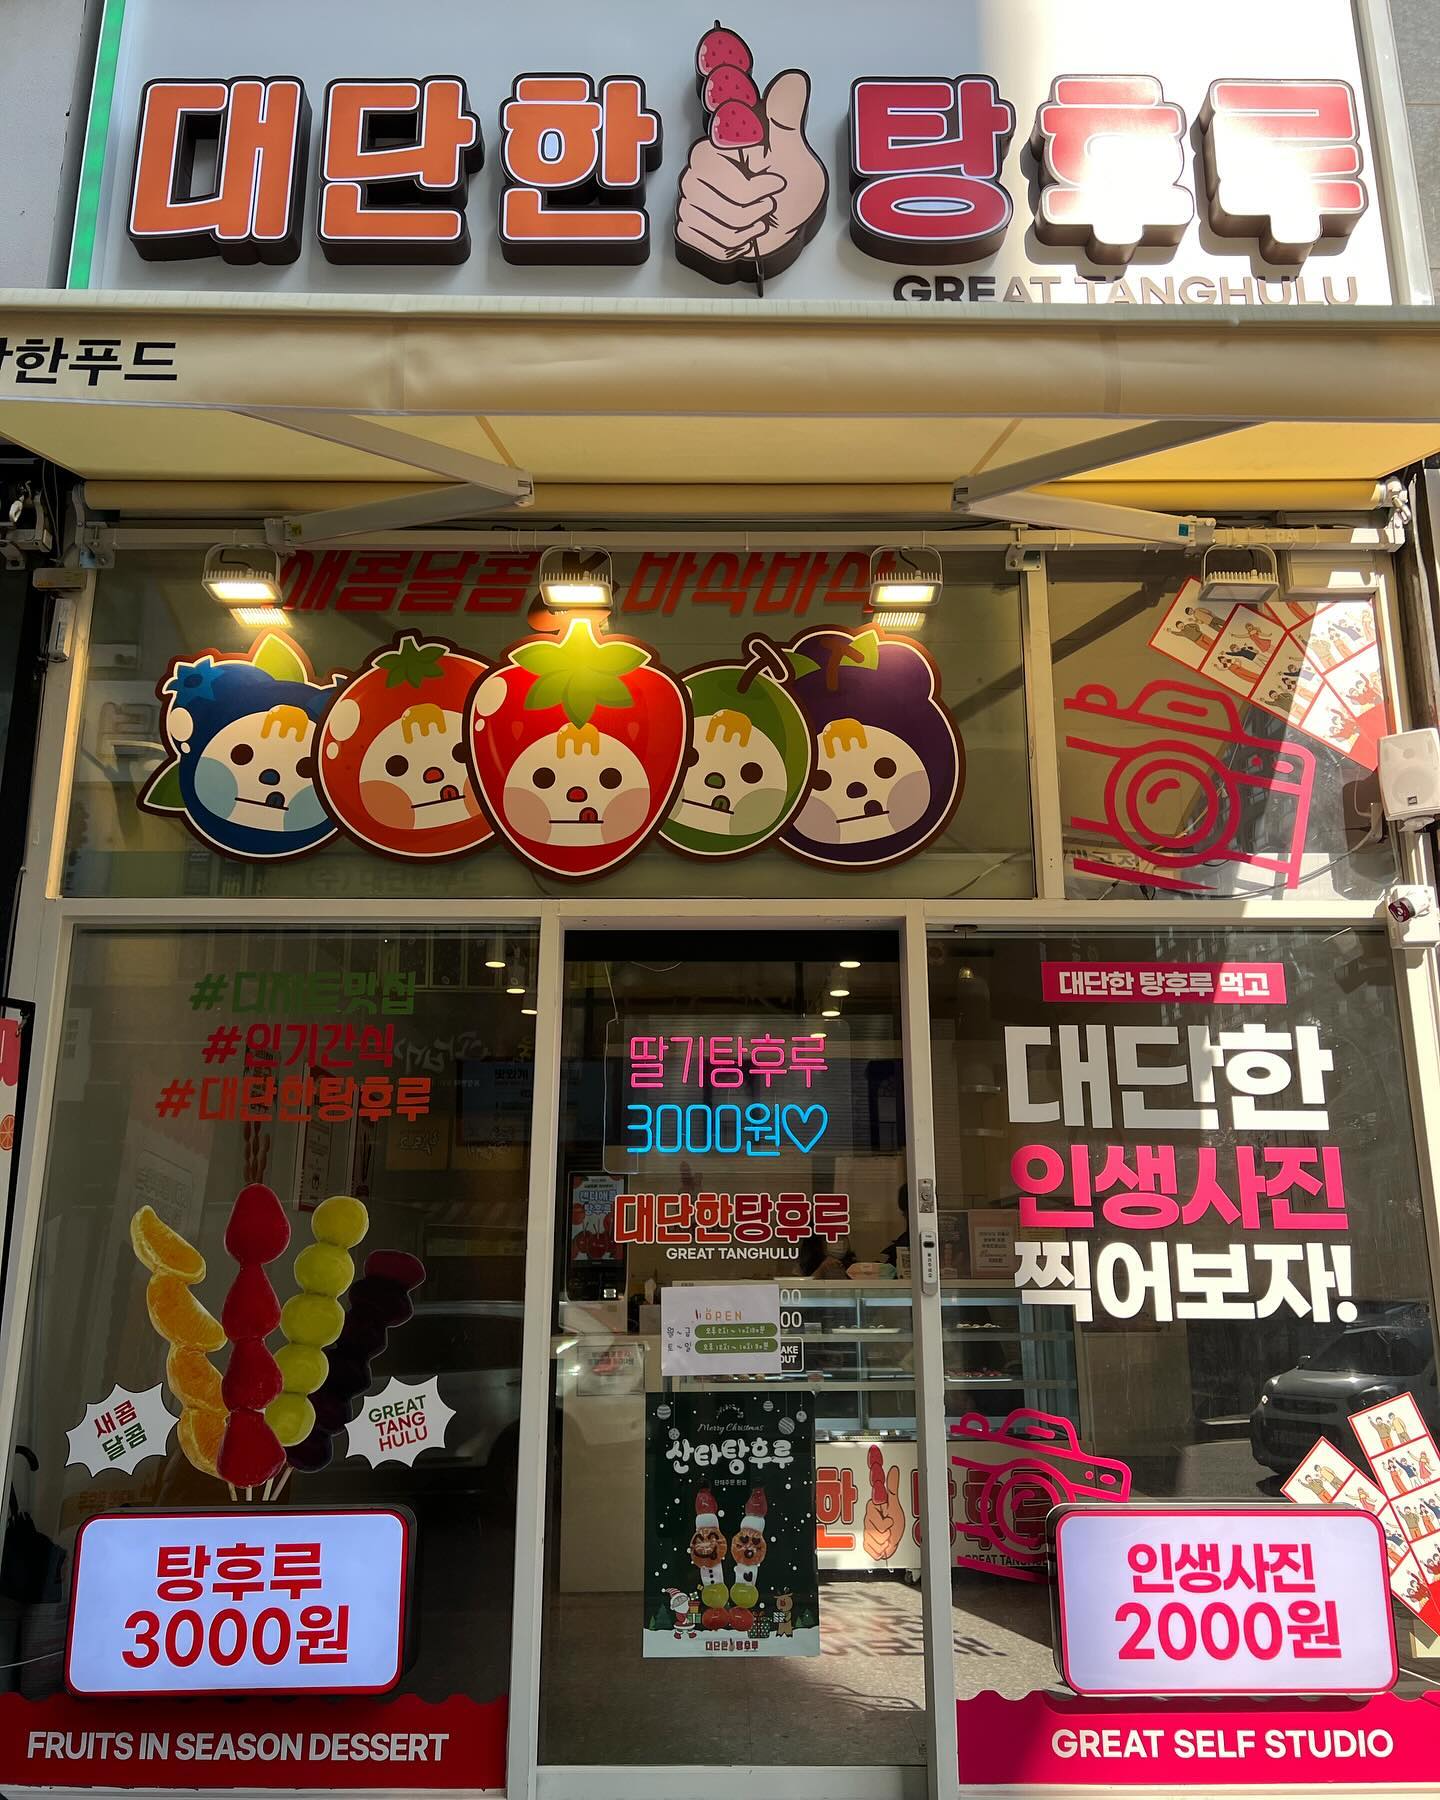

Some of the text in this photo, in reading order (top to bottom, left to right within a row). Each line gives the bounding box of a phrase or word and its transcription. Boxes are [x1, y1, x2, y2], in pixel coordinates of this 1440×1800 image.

[127, 72, 1369, 266] 대단한 탕후루
[893, 274, 1358, 305] GREAT TANGHULU
[189, 970, 417, 1015] #디저트맛집
[1059, 971, 1270, 997] 대단한 탕후루 먹고
[202, 1023, 395, 1067] #인기간식
[630, 1033, 829, 1089] 딸기탕후루
[1003, 1024, 1334, 1131] 대단한
[155, 1076, 432, 1122] #대단한탕후루
[626, 1103, 781, 1157] 3000원
[1010, 1144, 1350, 1230] 인생사진
[613, 1192, 851, 1244] 대단한탕후루
[665, 1247, 800, 1261] GREAT TANGHULU
[779, 1289, 802, 1305] 00
[1013, 1241, 1359, 1324] 찍어보자!
[706, 1309, 744, 1321] OPEN
[779, 1311, 803, 1329] 00
[780, 1345, 799, 1355] AKE
[94, 1399, 138, 1439] 새콤
[368, 1395, 428, 1424] GREAT
[374, 1412, 426, 1436] TANG
[101, 1425, 148, 1463] 달콤
[378, 1425, 429, 1453] HULU
[665, 1437, 794, 1474] 산타탕후루
[815, 1467, 858, 1551] 한
[155, 1541, 324, 1602] 탕후루
[1127, 1542, 1316, 1594] 인생사진
[121, 1604, 350, 1669] 3000원
[1114, 1600, 1342, 1662] 2000원
[26, 1731, 450, 1762] FRUITS IN SEASON DESSERT
[1051, 1729, 1395, 1759] GREAT SELF STUDIO
